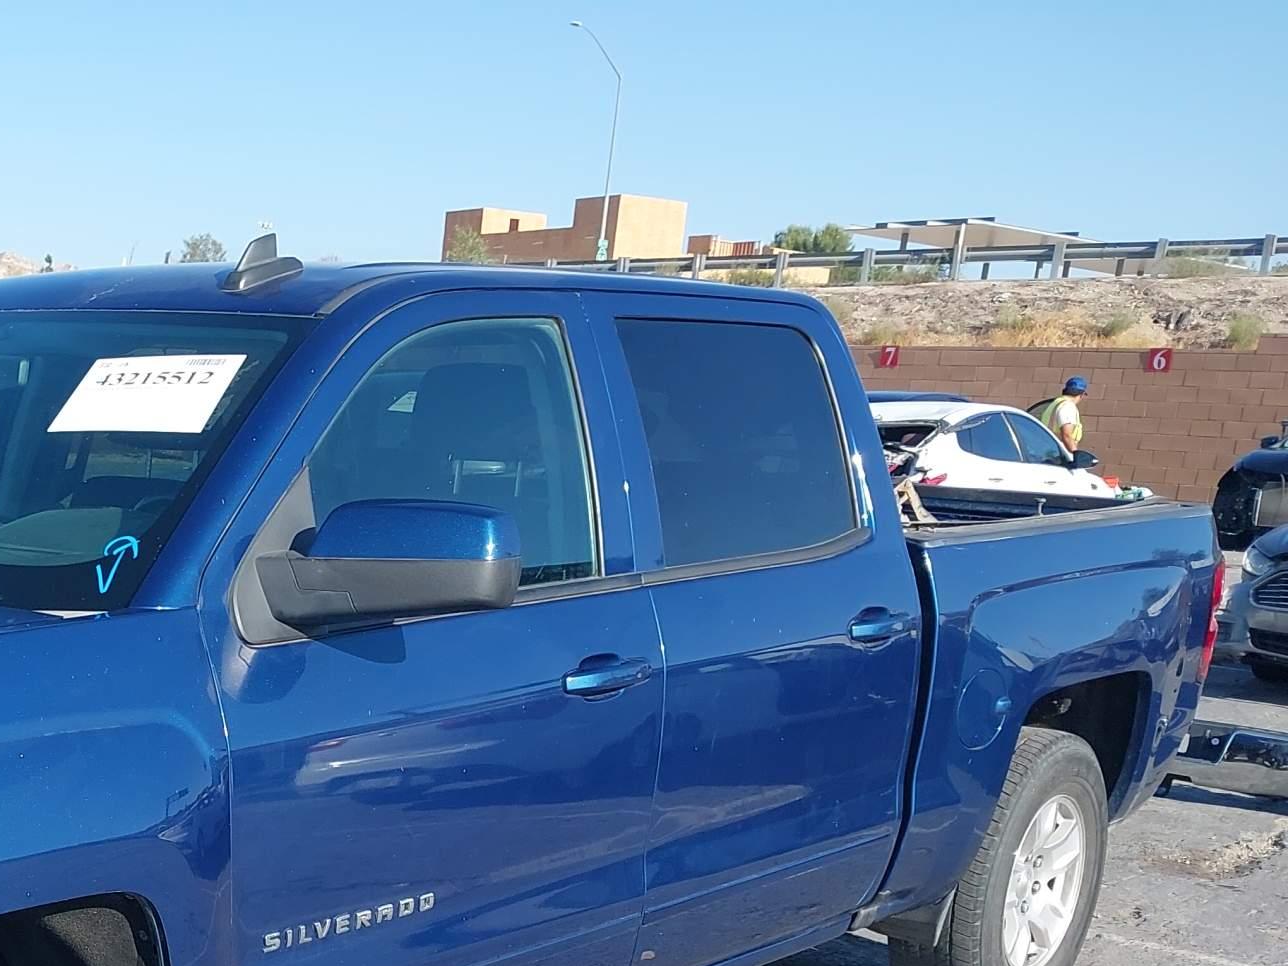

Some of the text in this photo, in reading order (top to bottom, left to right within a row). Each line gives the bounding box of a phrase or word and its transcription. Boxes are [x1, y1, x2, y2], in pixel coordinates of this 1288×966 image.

[885, 347, 897, 366] 7
[1153, 350, 1169, 370] 6
[96, 371, 214, 386] 43215512
[262, 892, 435, 953] SILVERADO
